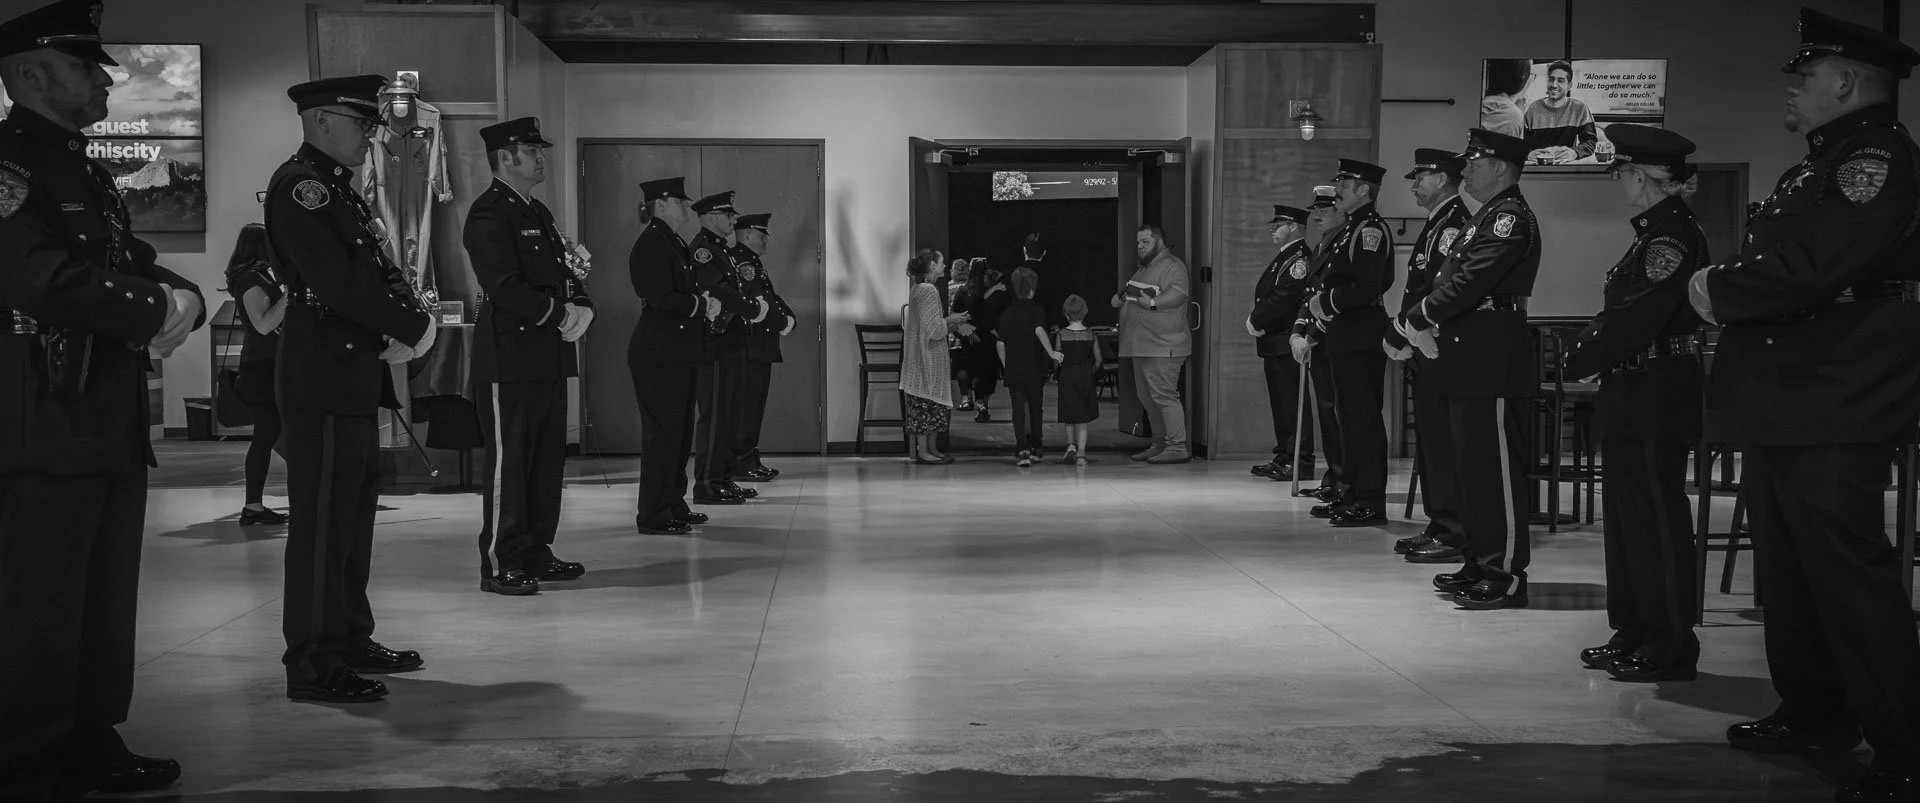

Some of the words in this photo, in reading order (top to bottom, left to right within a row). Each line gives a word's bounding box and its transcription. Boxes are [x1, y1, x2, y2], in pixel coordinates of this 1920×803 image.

[1576, 82, 1596, 90] little;
[1597, 82, 1630, 91] together
[85, 141, 161, 162] thiscity
[1864, 147, 1892, 159] GUARD
